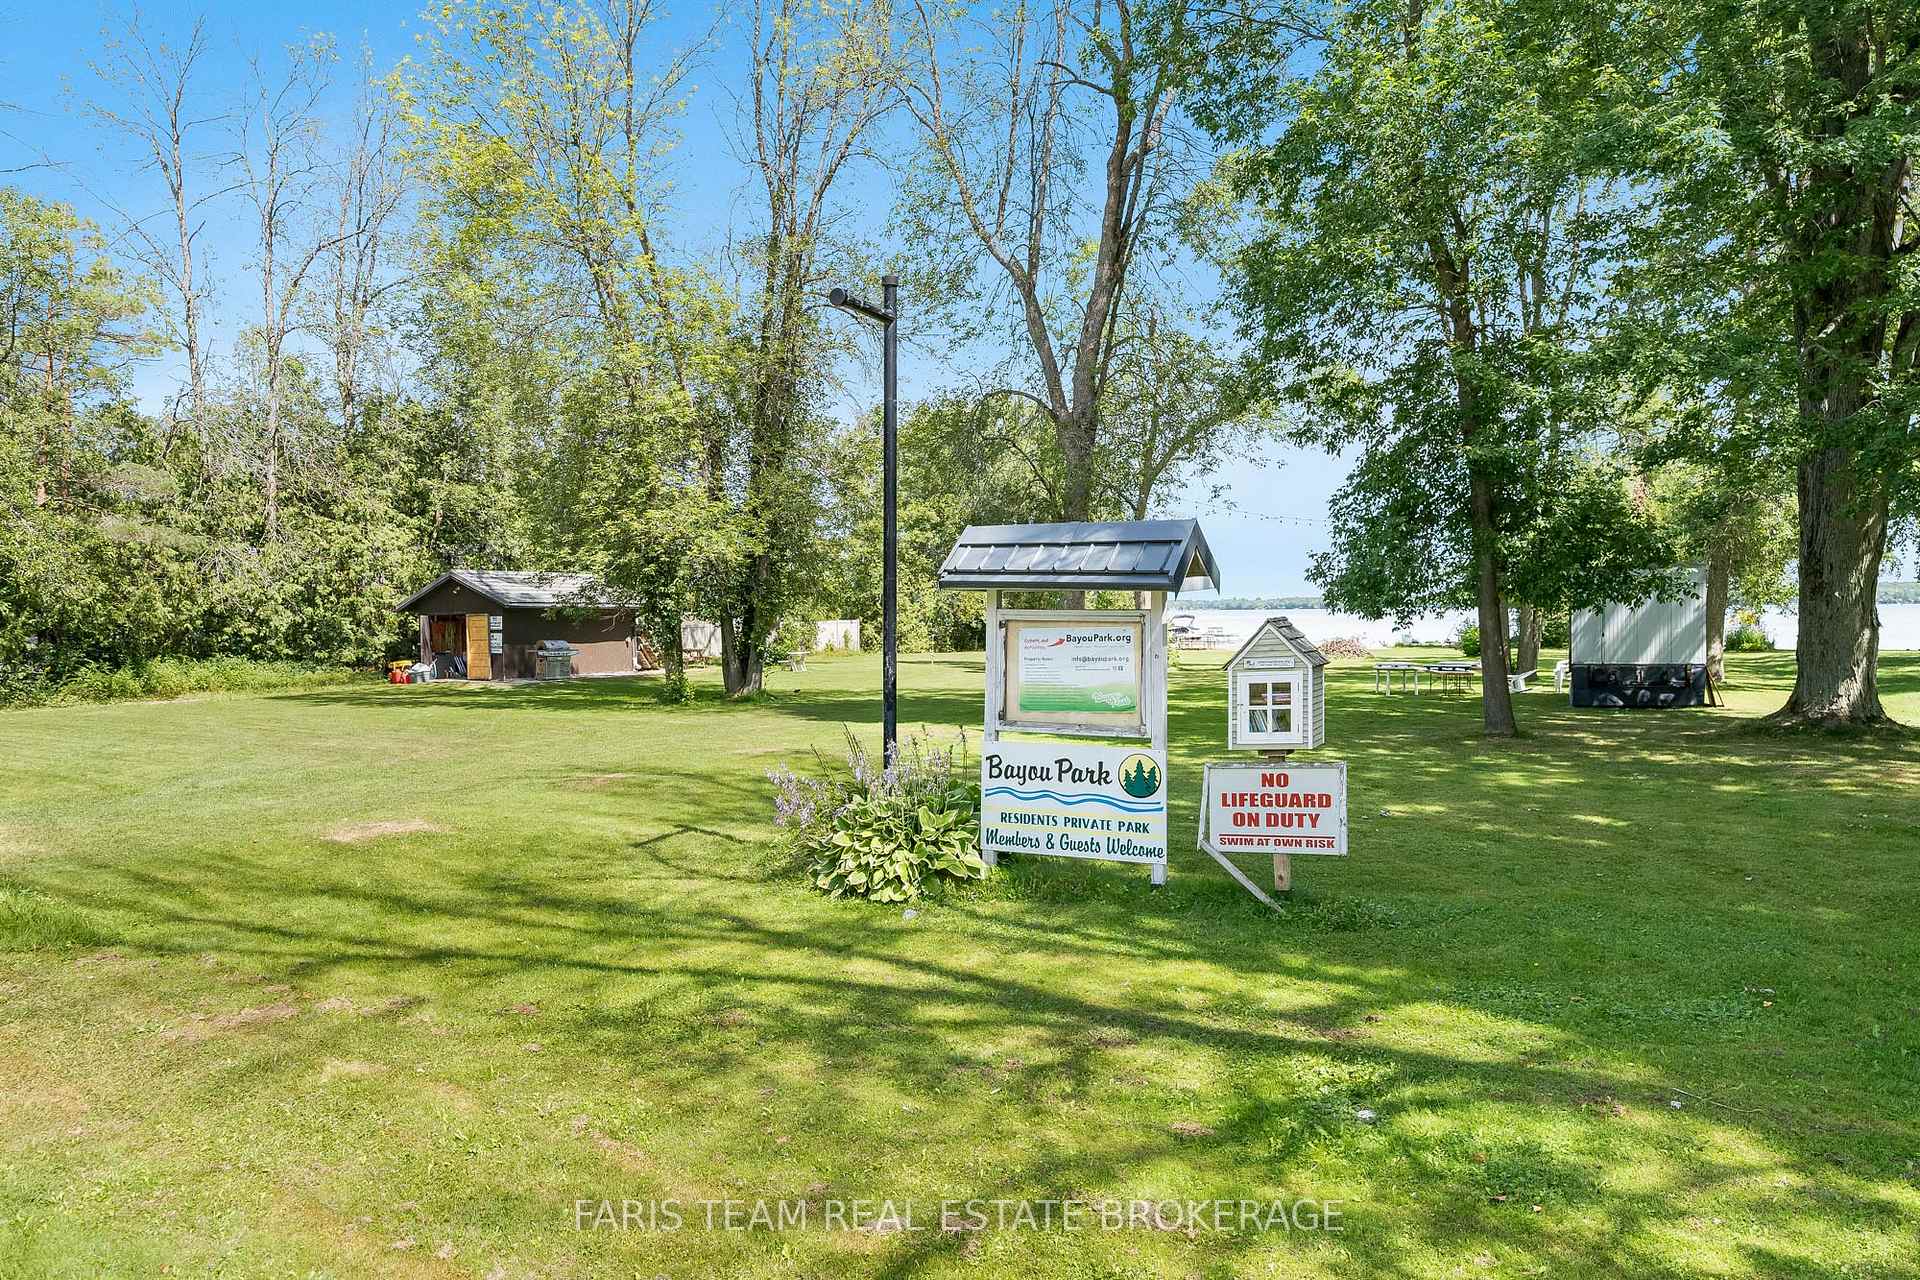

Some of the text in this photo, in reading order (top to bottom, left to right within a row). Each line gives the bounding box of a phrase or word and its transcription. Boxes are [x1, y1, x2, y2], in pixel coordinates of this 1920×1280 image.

[1066, 633, 1131, 644] BayouPark.org
[985, 754, 1112, 786] Bayou Park
[1261, 773, 1289, 788] NO
[1221, 792, 1332, 808] LIFEGUARD
[1000, 811, 1150, 834] RESIDENTS PRIVATE PARK
[1232, 812, 1321, 829] ON DUTY
[985, 827, 1165, 859] Members & Guests Welcome
[1219, 837, 1335, 849] SWIM AT OWN RISK
